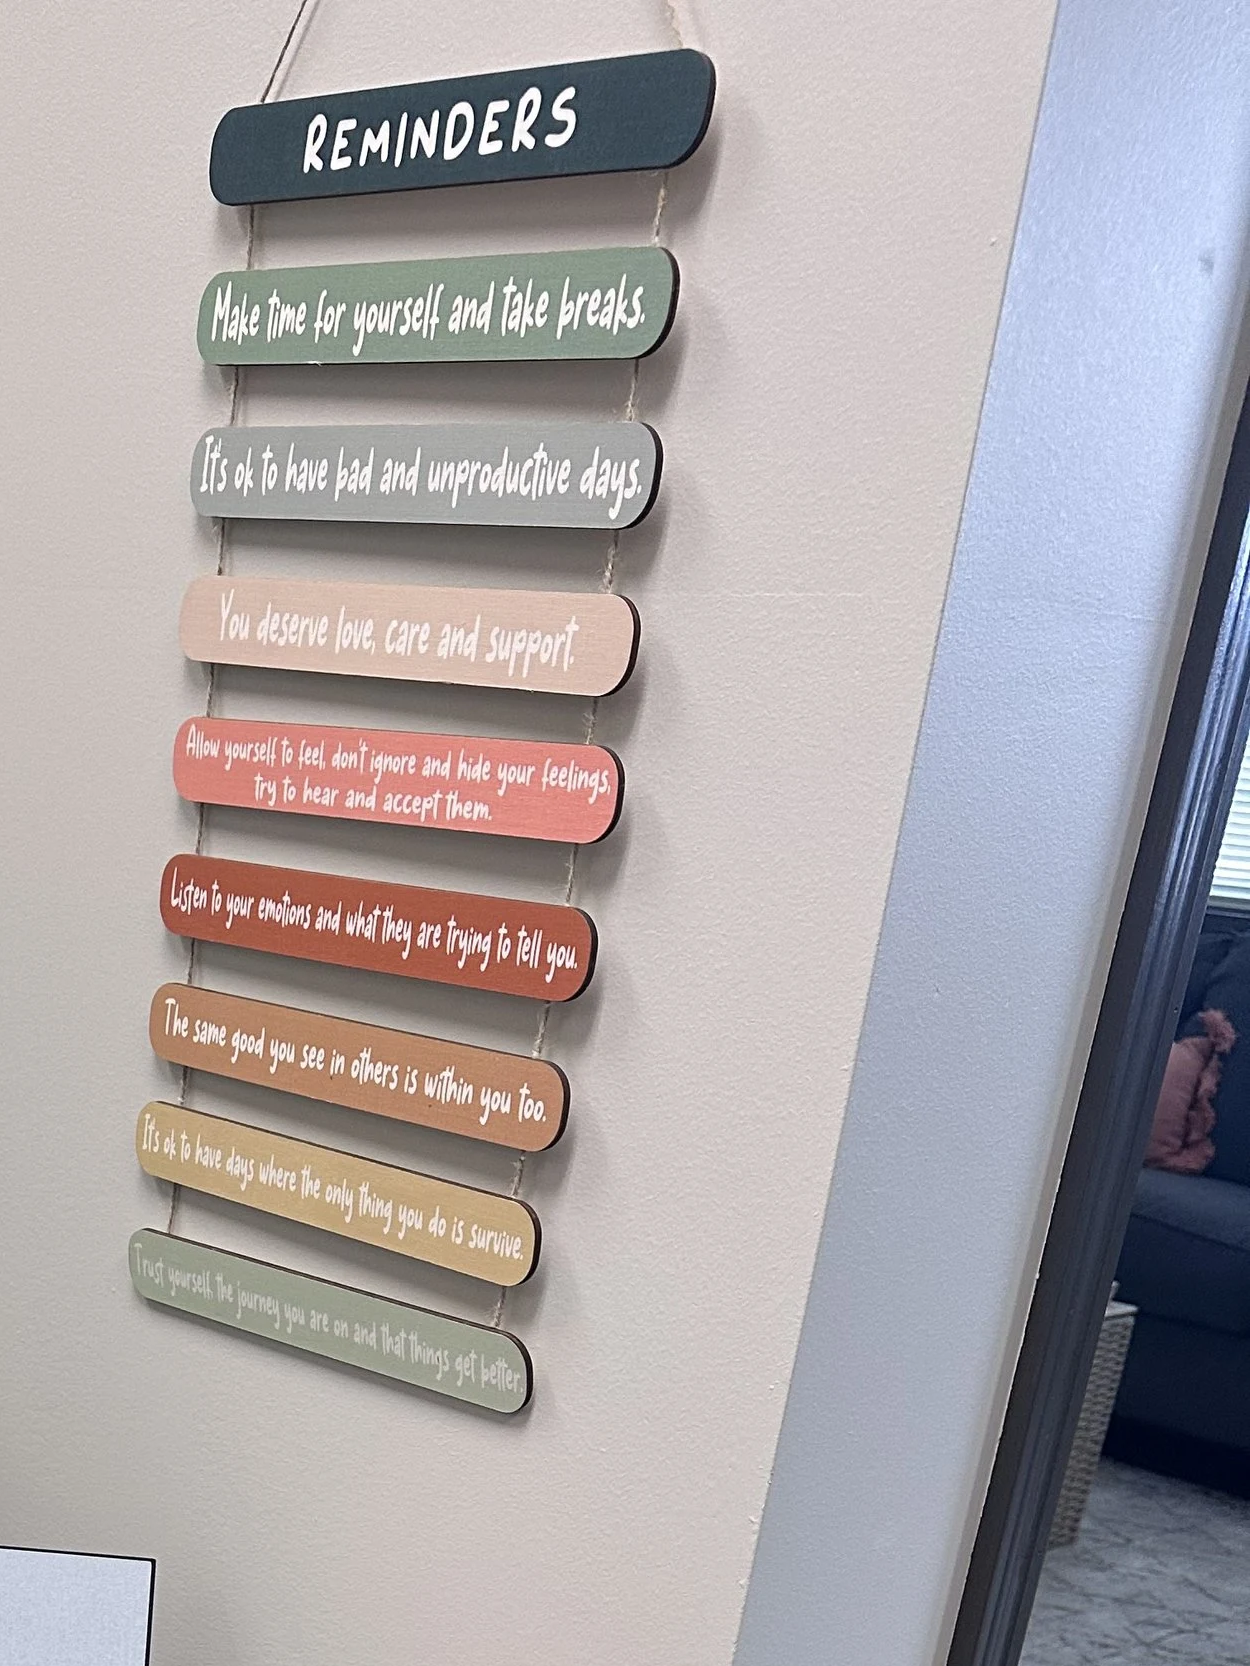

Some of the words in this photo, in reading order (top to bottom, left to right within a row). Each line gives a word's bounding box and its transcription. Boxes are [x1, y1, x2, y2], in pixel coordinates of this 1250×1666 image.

[303, 86, 577, 173] REMINDERS
[212, 281, 260, 345] Make
[267, 289, 307, 342] time
[314, 289, 346, 343] for
[352, 283, 444, 356] yourself
[448, 281, 495, 334] and
[502, 276, 549, 338] take
[556, 273, 645, 340] breaks.
[200, 435, 228, 495] It's
[234, 447, 254, 497] ok
[262, 444, 278, 496] to
[285, 442, 328, 494] have
[335, 447, 374, 502] bad
[379, 447, 421, 496] and
[428, 442, 571, 508] unproductive
[580, 446, 642, 520] days.
[220, 588, 250, 641] You
[257, 602, 329, 648] deserve
[335, 605, 375, 655] love,
[385, 619, 430, 656] care
[437, 614, 481, 662] and
[485, 616, 579, 678] support.
[186, 724, 220, 760] Allow
[225, 736, 277, 771] yourself
[281, 736, 293, 767] to
[331, 737, 368, 774] don't
[370, 750, 416, 784] ignore
[422, 751, 451, 780] and
[457, 748, 490, 783] hide
[498, 762, 535, 797] your
[254, 773, 276, 806] try
[282, 776, 296, 803] to
[303, 776, 339, 807] hear
[345, 785, 377, 811] and
[383, 789, 442, 822] accept
[445, 790, 492, 821] them.
[170, 867, 207, 915] Listen
[211, 879, 222, 916] to
[225, 892, 254, 930] your
[258, 890, 312, 930] emotions
[315, 901, 342, 936] and
[345, 901, 381, 943] what
[382, 904, 412, 960] they
[416, 921, 442, 949] are
[446, 915, 492, 972] trying
[497, 922, 511, 963] to
[516, 925, 543, 969] tell
[545, 942, 578, 983] you.
[165, 998, 188, 1037] The
[192, 1018, 226, 1047] same
[231, 1027, 265, 1064] good
[269, 1038, 295, 1074] you
[300, 1043, 325, 1071] see
[329, 1049, 345, 1076] in
[350, 1047, 399, 1090] others
[404, 1066, 418, 1094] is
[424, 1065, 473, 1105] within
[479, 1086, 511, 1126] you
[518, 1082, 546, 1123] too.
[142, 1113, 160, 1153] It's
[163, 1129, 176, 1160] ok
[180, 1130, 191, 1163] to
[195, 1133, 222, 1169] have
[226, 1147, 254, 1191] days
[259, 1154, 297, 1192] where
[301, 1164, 321, 1200] the
[325, 1178, 353, 1223] only
[359, 1181, 393, 1234] thing
[399, 1206, 423, 1240] you
[428, 1206, 446, 1237] do
[451, 1217, 465, 1245] is
[468, 1223, 524, 1260] survive.
[134, 1243, 164, 1287] Trust
[215, 1272, 234, 1302] the
[236, 1280, 280, 1330] journey
[284, 1303, 305, 1334] you
[310, 1309, 329, 1333] are
[334, 1319, 349, 1338] on
[354, 1322, 376, 1350] and
[380, 1323, 407, 1361] that
[409, 1331, 450, 1380] things
[455, 1349, 477, 1387] get
[481, 1353, 524, 1393] better.
